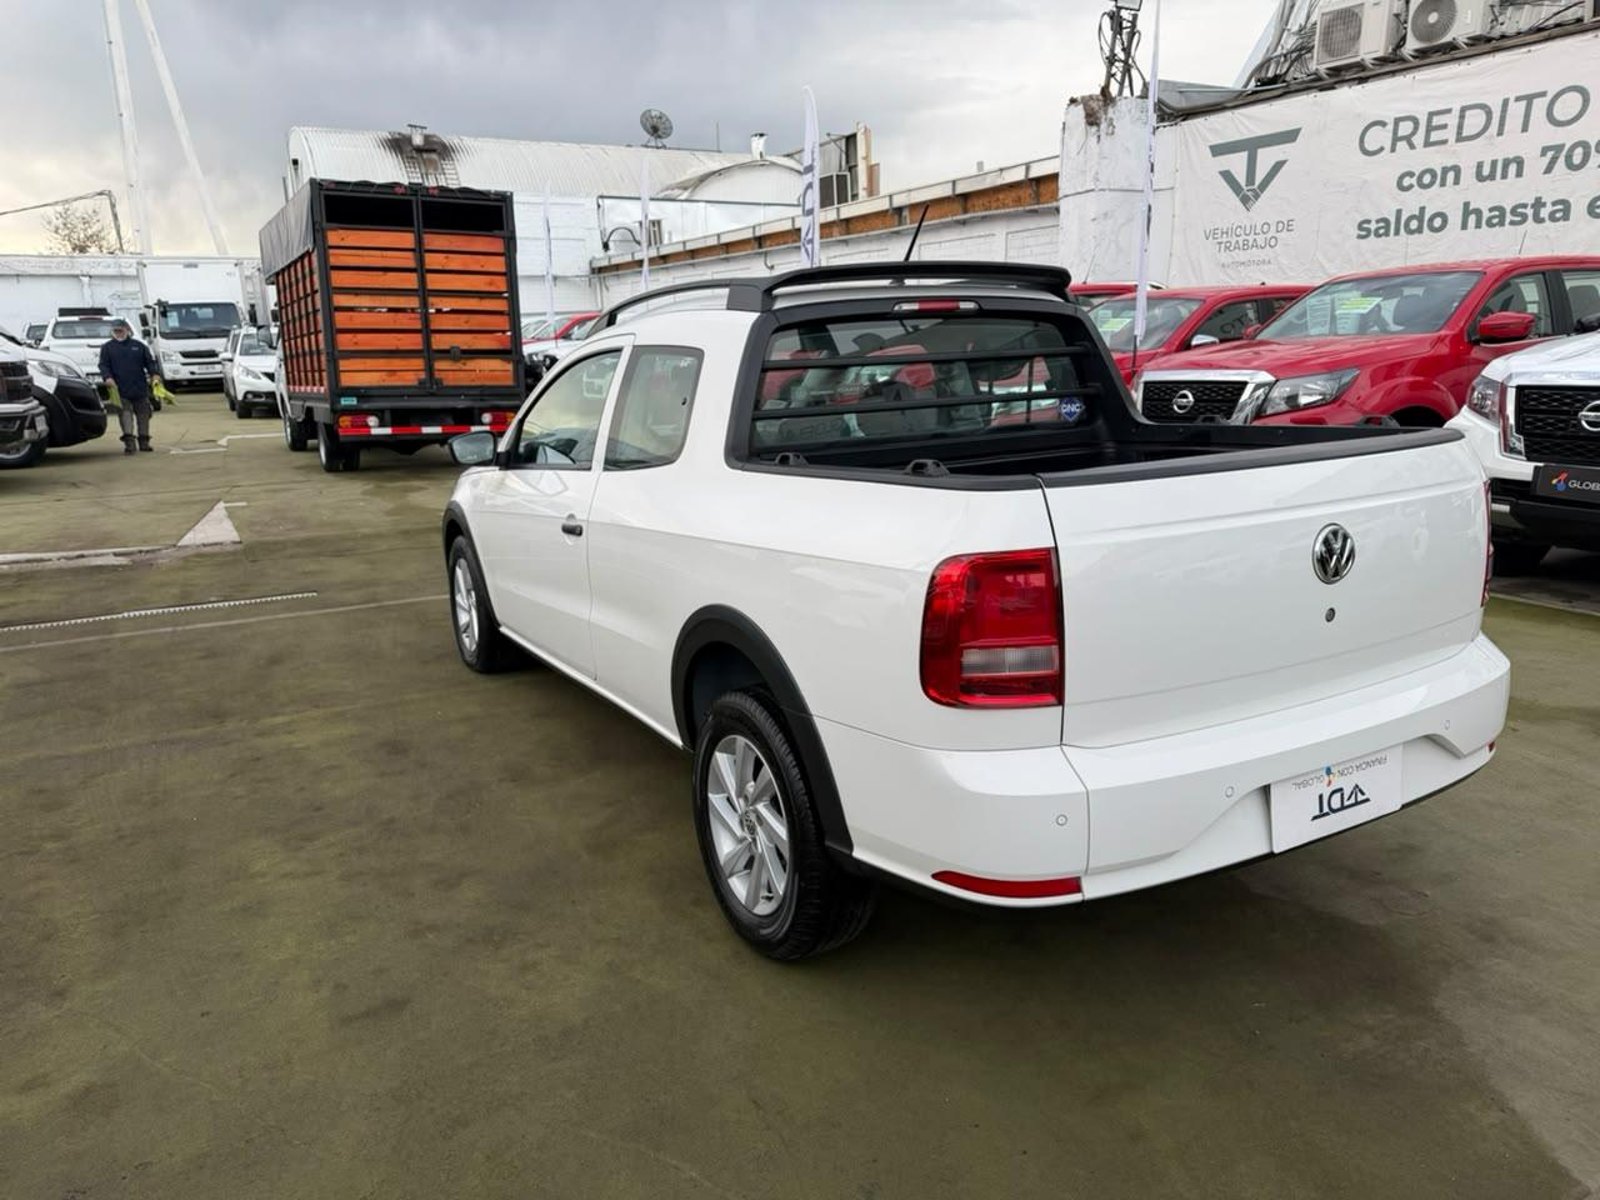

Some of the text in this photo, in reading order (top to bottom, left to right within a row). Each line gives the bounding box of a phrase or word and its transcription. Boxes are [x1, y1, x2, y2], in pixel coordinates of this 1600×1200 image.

[1358, 84, 1591, 157] CREDITO
[1396, 163, 1462, 192] con
[1475, 155, 1525, 183] un
[1203, 218, 1296, 241] VEHÍCULO DE
[1355, 205, 1449, 240] saldo
[1460, 195, 1572, 231] hasta
[1215, 235, 1279, 254] TRABAJO
